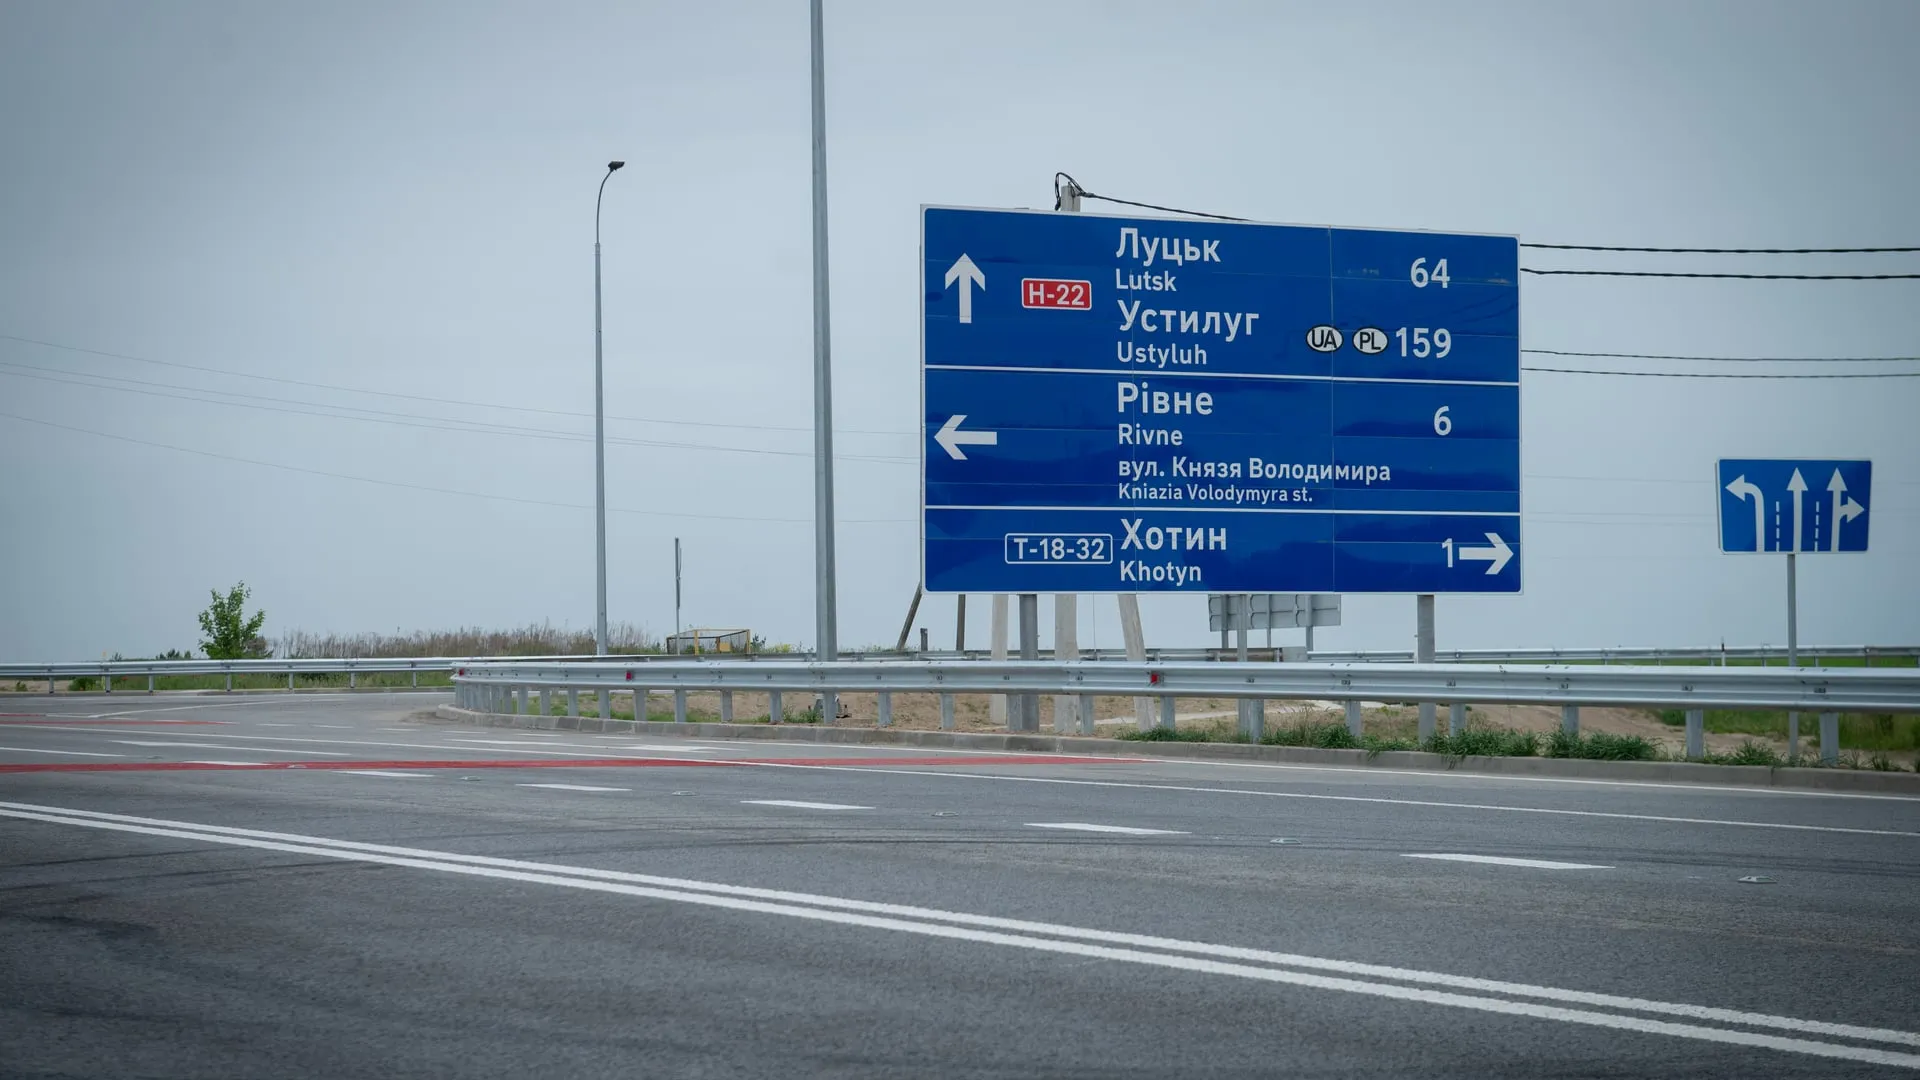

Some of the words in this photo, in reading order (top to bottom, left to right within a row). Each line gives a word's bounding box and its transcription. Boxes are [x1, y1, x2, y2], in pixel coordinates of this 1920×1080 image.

[1115, 227, 1221, 267] Луцьк
[1116, 268, 1176, 291] Lutsk
[1410, 257, 1450, 288] 64
[1117, 299, 1259, 342] Устилуг
[1117, 341, 1207, 369] Ustyluh
[1312, 328, 1337, 348] UA
[1360, 332, 1381, 350] PL
[1396, 327, 1452, 358] 159
[1118, 382, 1213, 415] Рівне
[1118, 423, 1183, 446] Rivne
[1434, 406, 1452, 436] 6
[1119, 461, 1165, 481] вул.
[1172, 456, 1242, 478] Князя
[1249, 457, 1391, 485] Володимира
[1118, 482, 1183, 500] Kniazia
[1187, 484, 1289, 505] Volodymyra
[1292, 487, 1313, 502] st.
[1121, 518, 1226, 551] Хотин
[1442, 538, 1453, 568] 1
[1120, 560, 1201, 586] Khotyn
